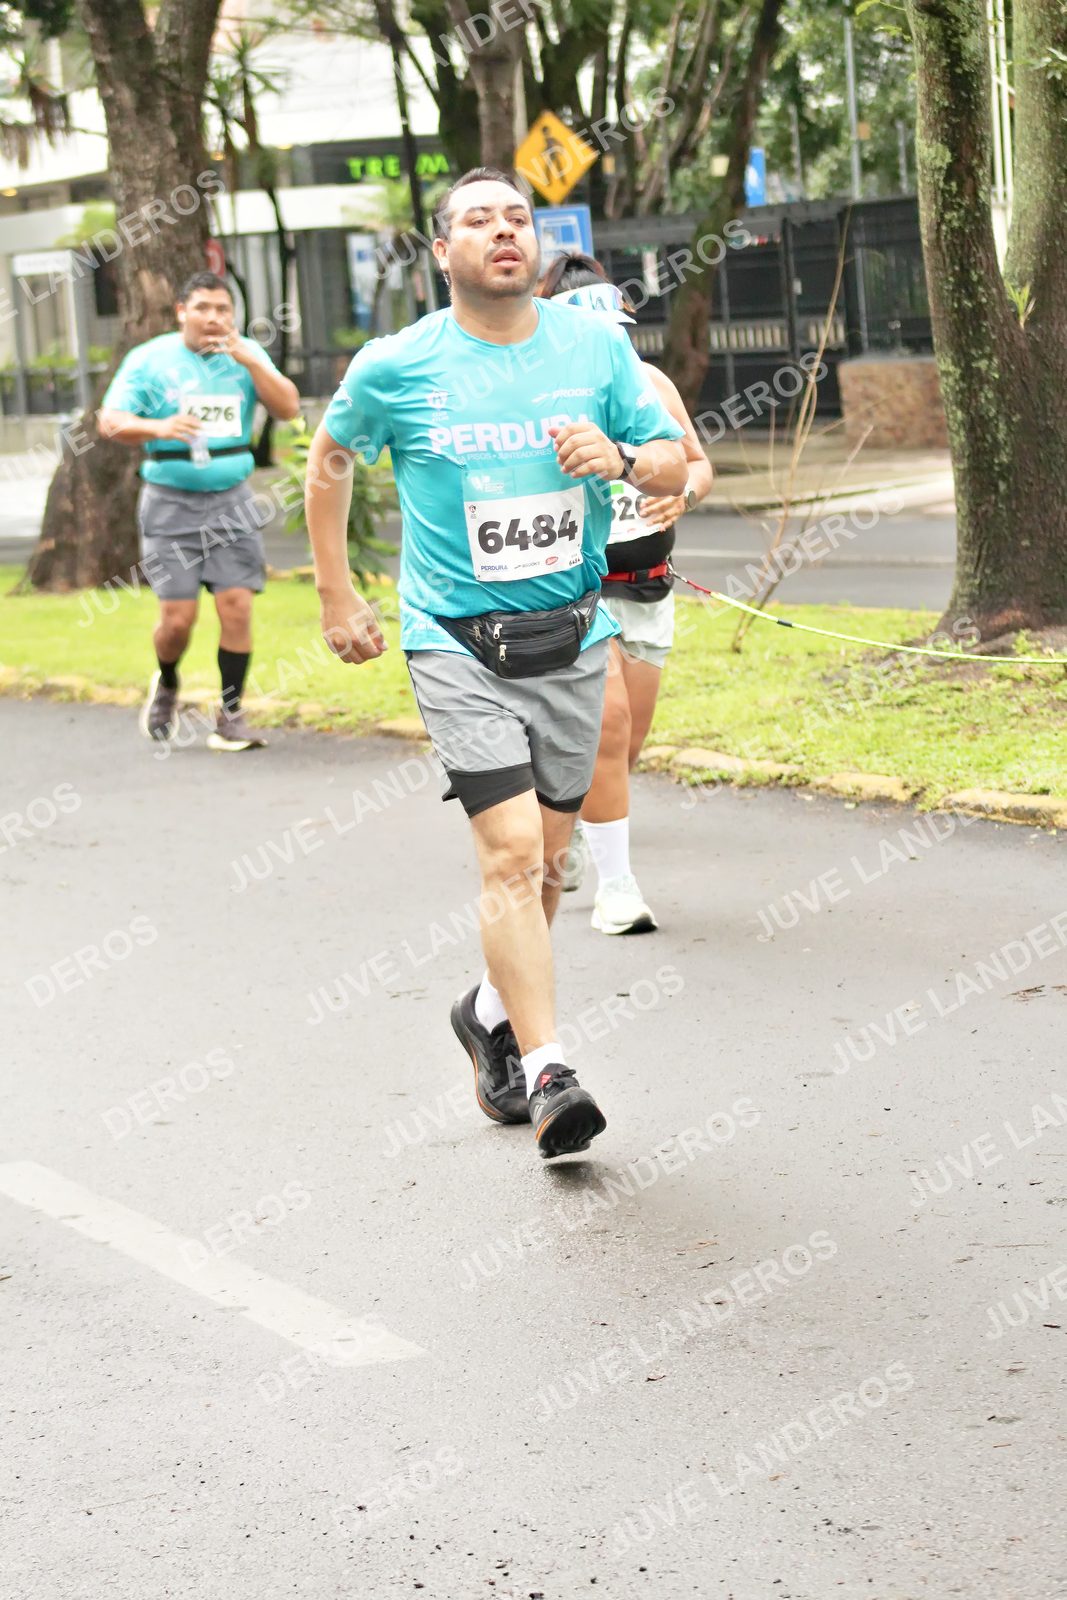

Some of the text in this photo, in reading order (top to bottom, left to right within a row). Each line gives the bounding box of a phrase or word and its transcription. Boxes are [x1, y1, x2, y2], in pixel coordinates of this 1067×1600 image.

[346, 153, 450, 180] TREM
[478, 509, 578, 555] 6484
[480, 563, 508, 572] PERDURA
